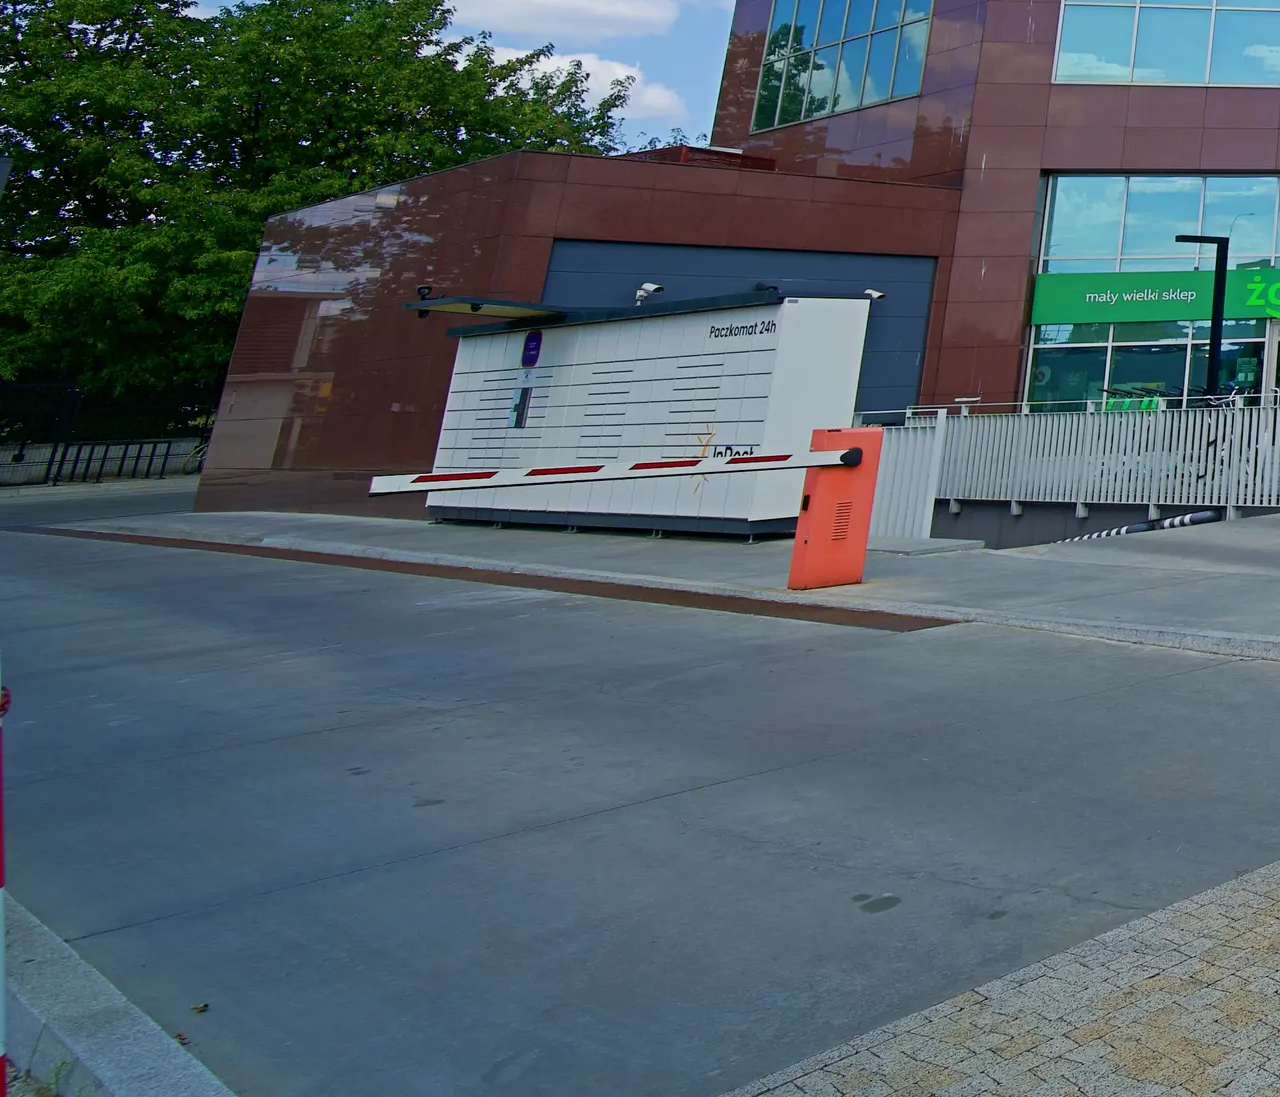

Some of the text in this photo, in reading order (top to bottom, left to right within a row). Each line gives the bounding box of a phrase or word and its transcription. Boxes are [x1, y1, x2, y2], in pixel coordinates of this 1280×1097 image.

[1085, 288, 1197, 305] mały wielki sklep
[708, 319, 777, 339] Paczkomat 24h
